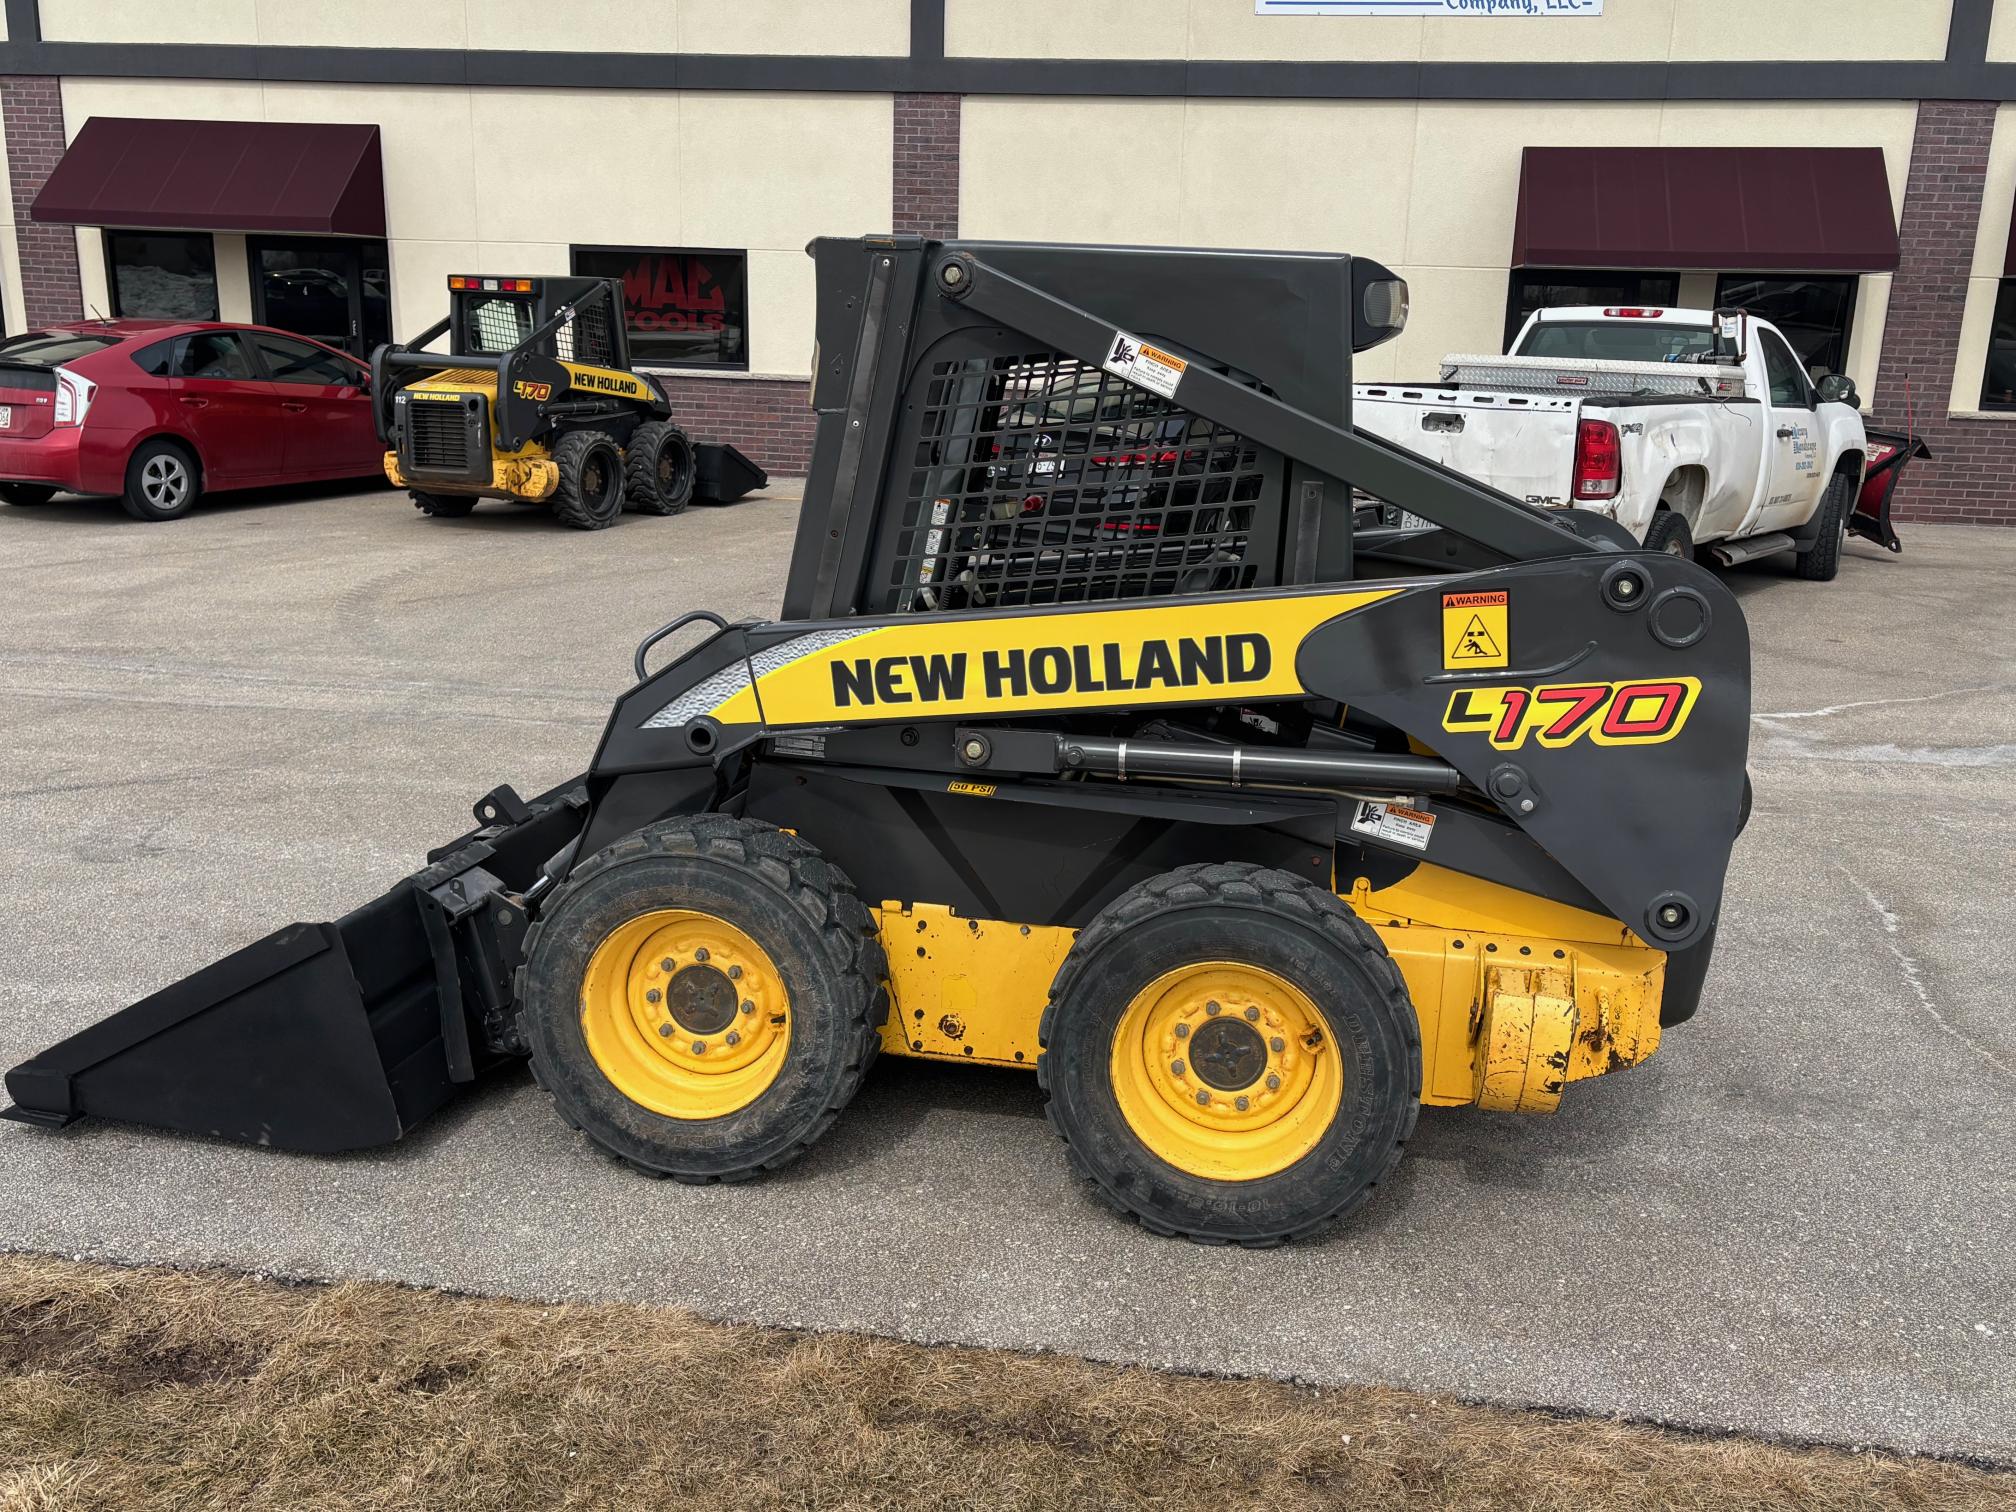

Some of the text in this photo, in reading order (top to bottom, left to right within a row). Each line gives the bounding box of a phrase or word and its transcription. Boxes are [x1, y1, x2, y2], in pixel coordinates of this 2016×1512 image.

[622, 254, 725, 310] MAC
[624, 310, 726, 332] TOOLS
[1151, 351, 1182, 369] WARNING
[513, 381, 551, 400] L170
[574, 372, 637, 395] NEW HOLLAND
[395, 395, 406, 404] 112
[413, 392, 460, 401] NEW HOLLAND
[1526, 495, 1561, 505] GMC
[1455, 594, 1505, 606] WARNING
[830, 632, 1272, 708] NEW HOLLAND
[1445, 681, 1692, 744] L170
[971, 784, 991, 793] PSI
[1398, 809, 1430, 822] WARNING
